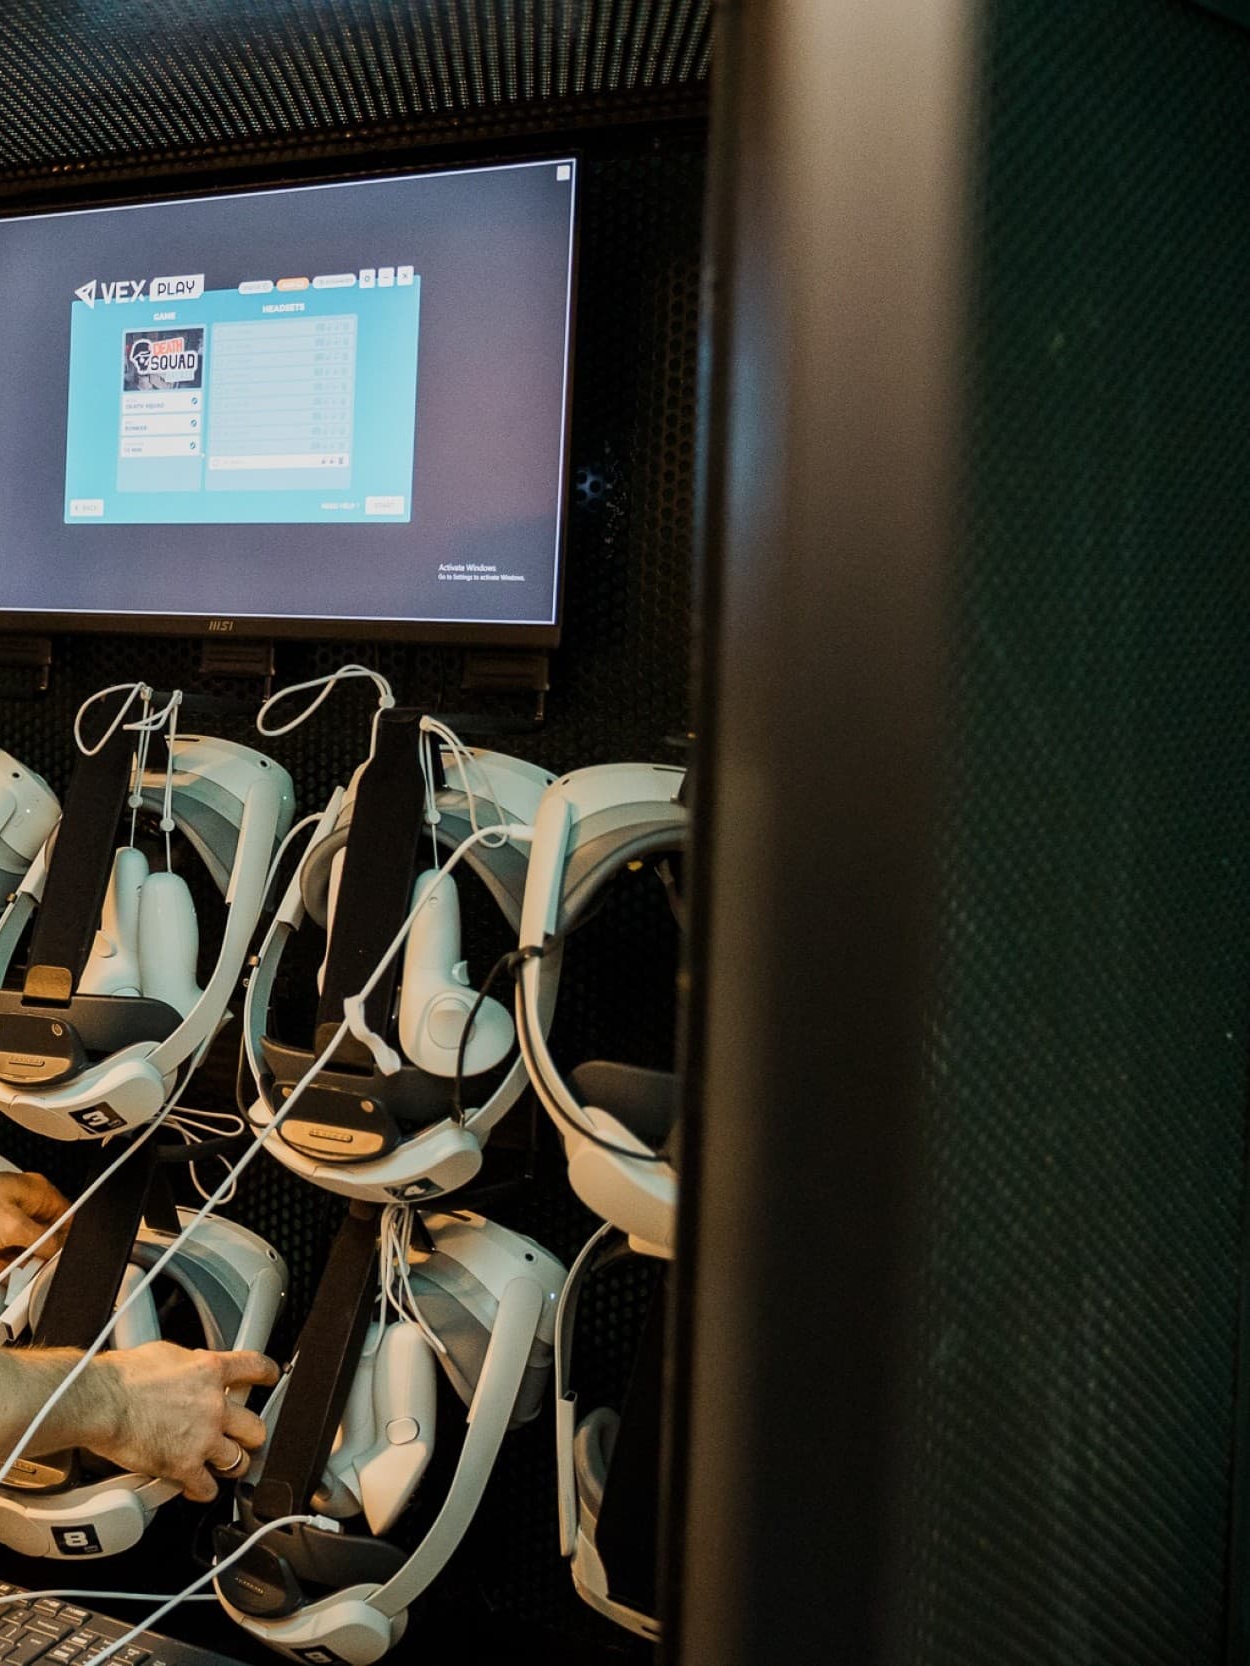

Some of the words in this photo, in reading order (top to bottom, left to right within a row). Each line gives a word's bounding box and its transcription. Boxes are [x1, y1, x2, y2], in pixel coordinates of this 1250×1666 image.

[100, 279, 147, 304] VEX
[157, 280, 195, 295] PLAY
[153, 311, 176, 321] GAME
[262, 303, 305, 313] HEADSETS
[153, 339, 183, 355] DEATH
[150, 353, 195, 371] SQUAD
[438, 563, 465, 572] Activate
[466, 563, 497, 572] Windows
[82, 1110, 110, 1126] 3
[63, 1531, 89, 1547] 8
